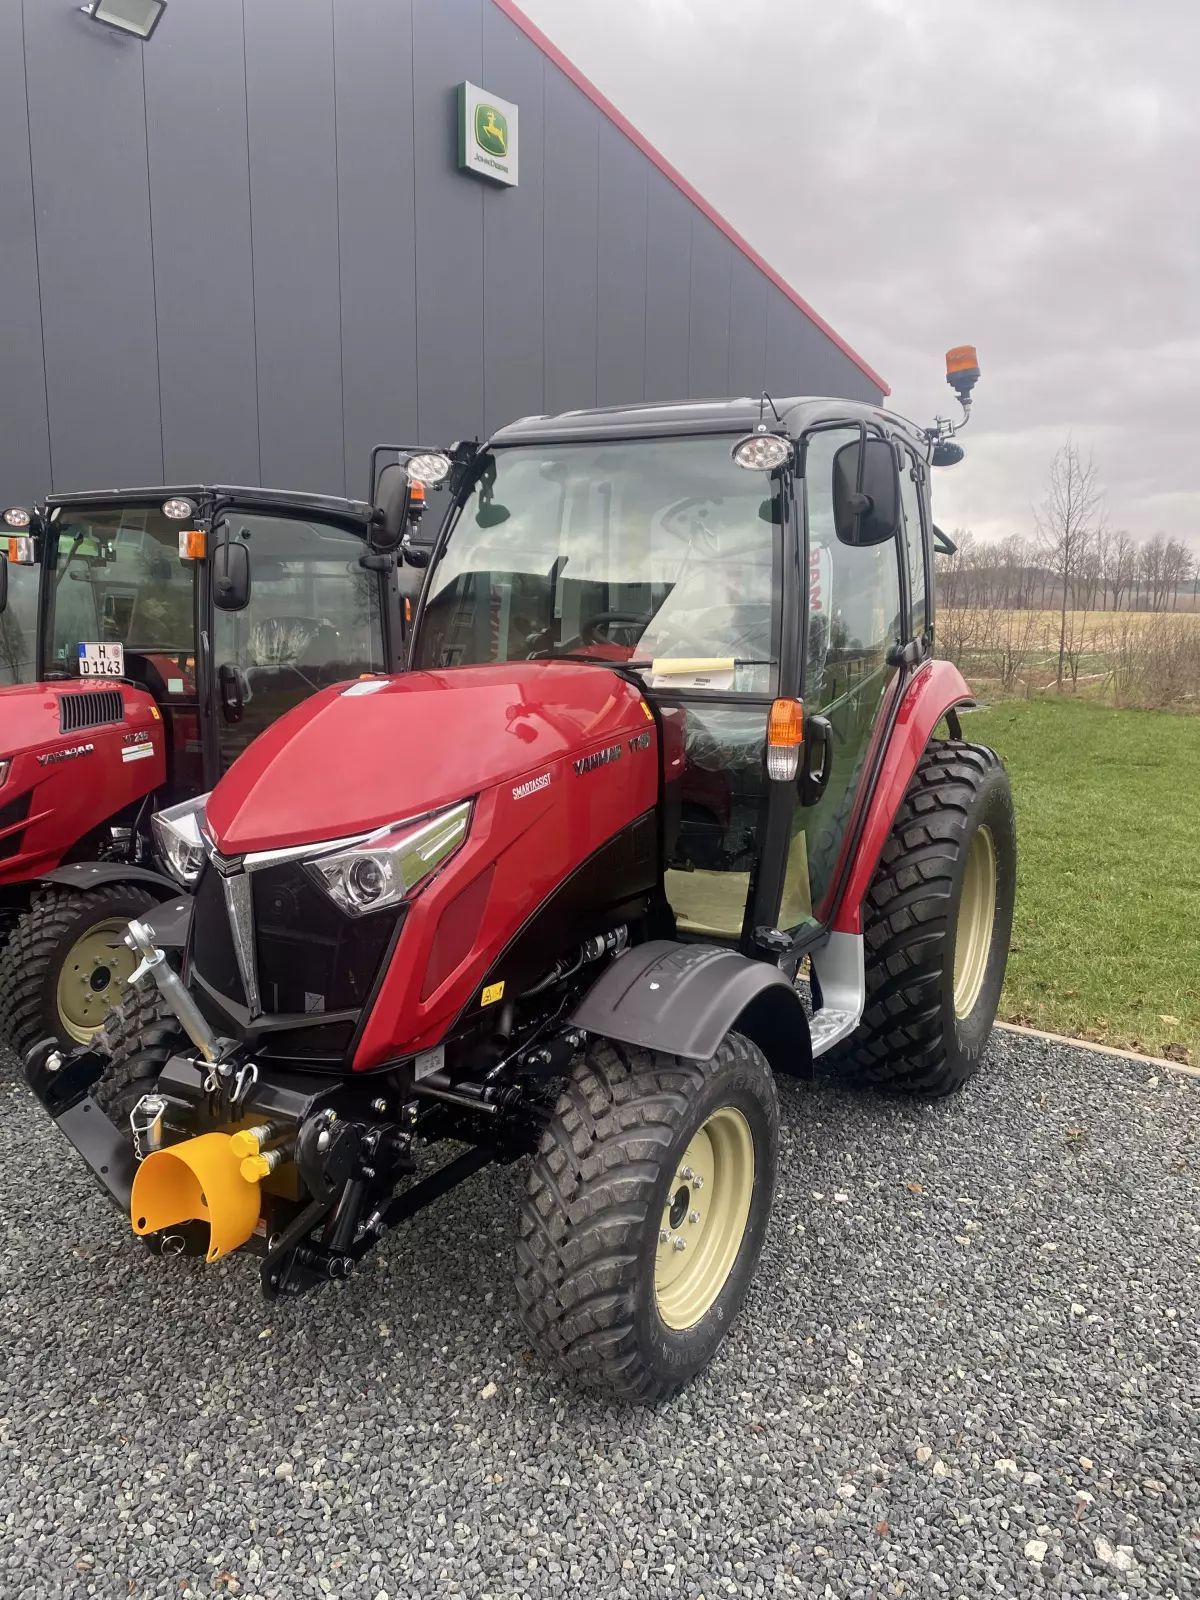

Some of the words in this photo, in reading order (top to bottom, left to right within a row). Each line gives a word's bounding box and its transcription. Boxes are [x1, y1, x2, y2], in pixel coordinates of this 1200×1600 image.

[98, 645, 106, 658] H
[82, 661, 90, 673] D
[93, 661, 120, 674] 1143
[512, 772, 551, 800] SMARTASSIST
